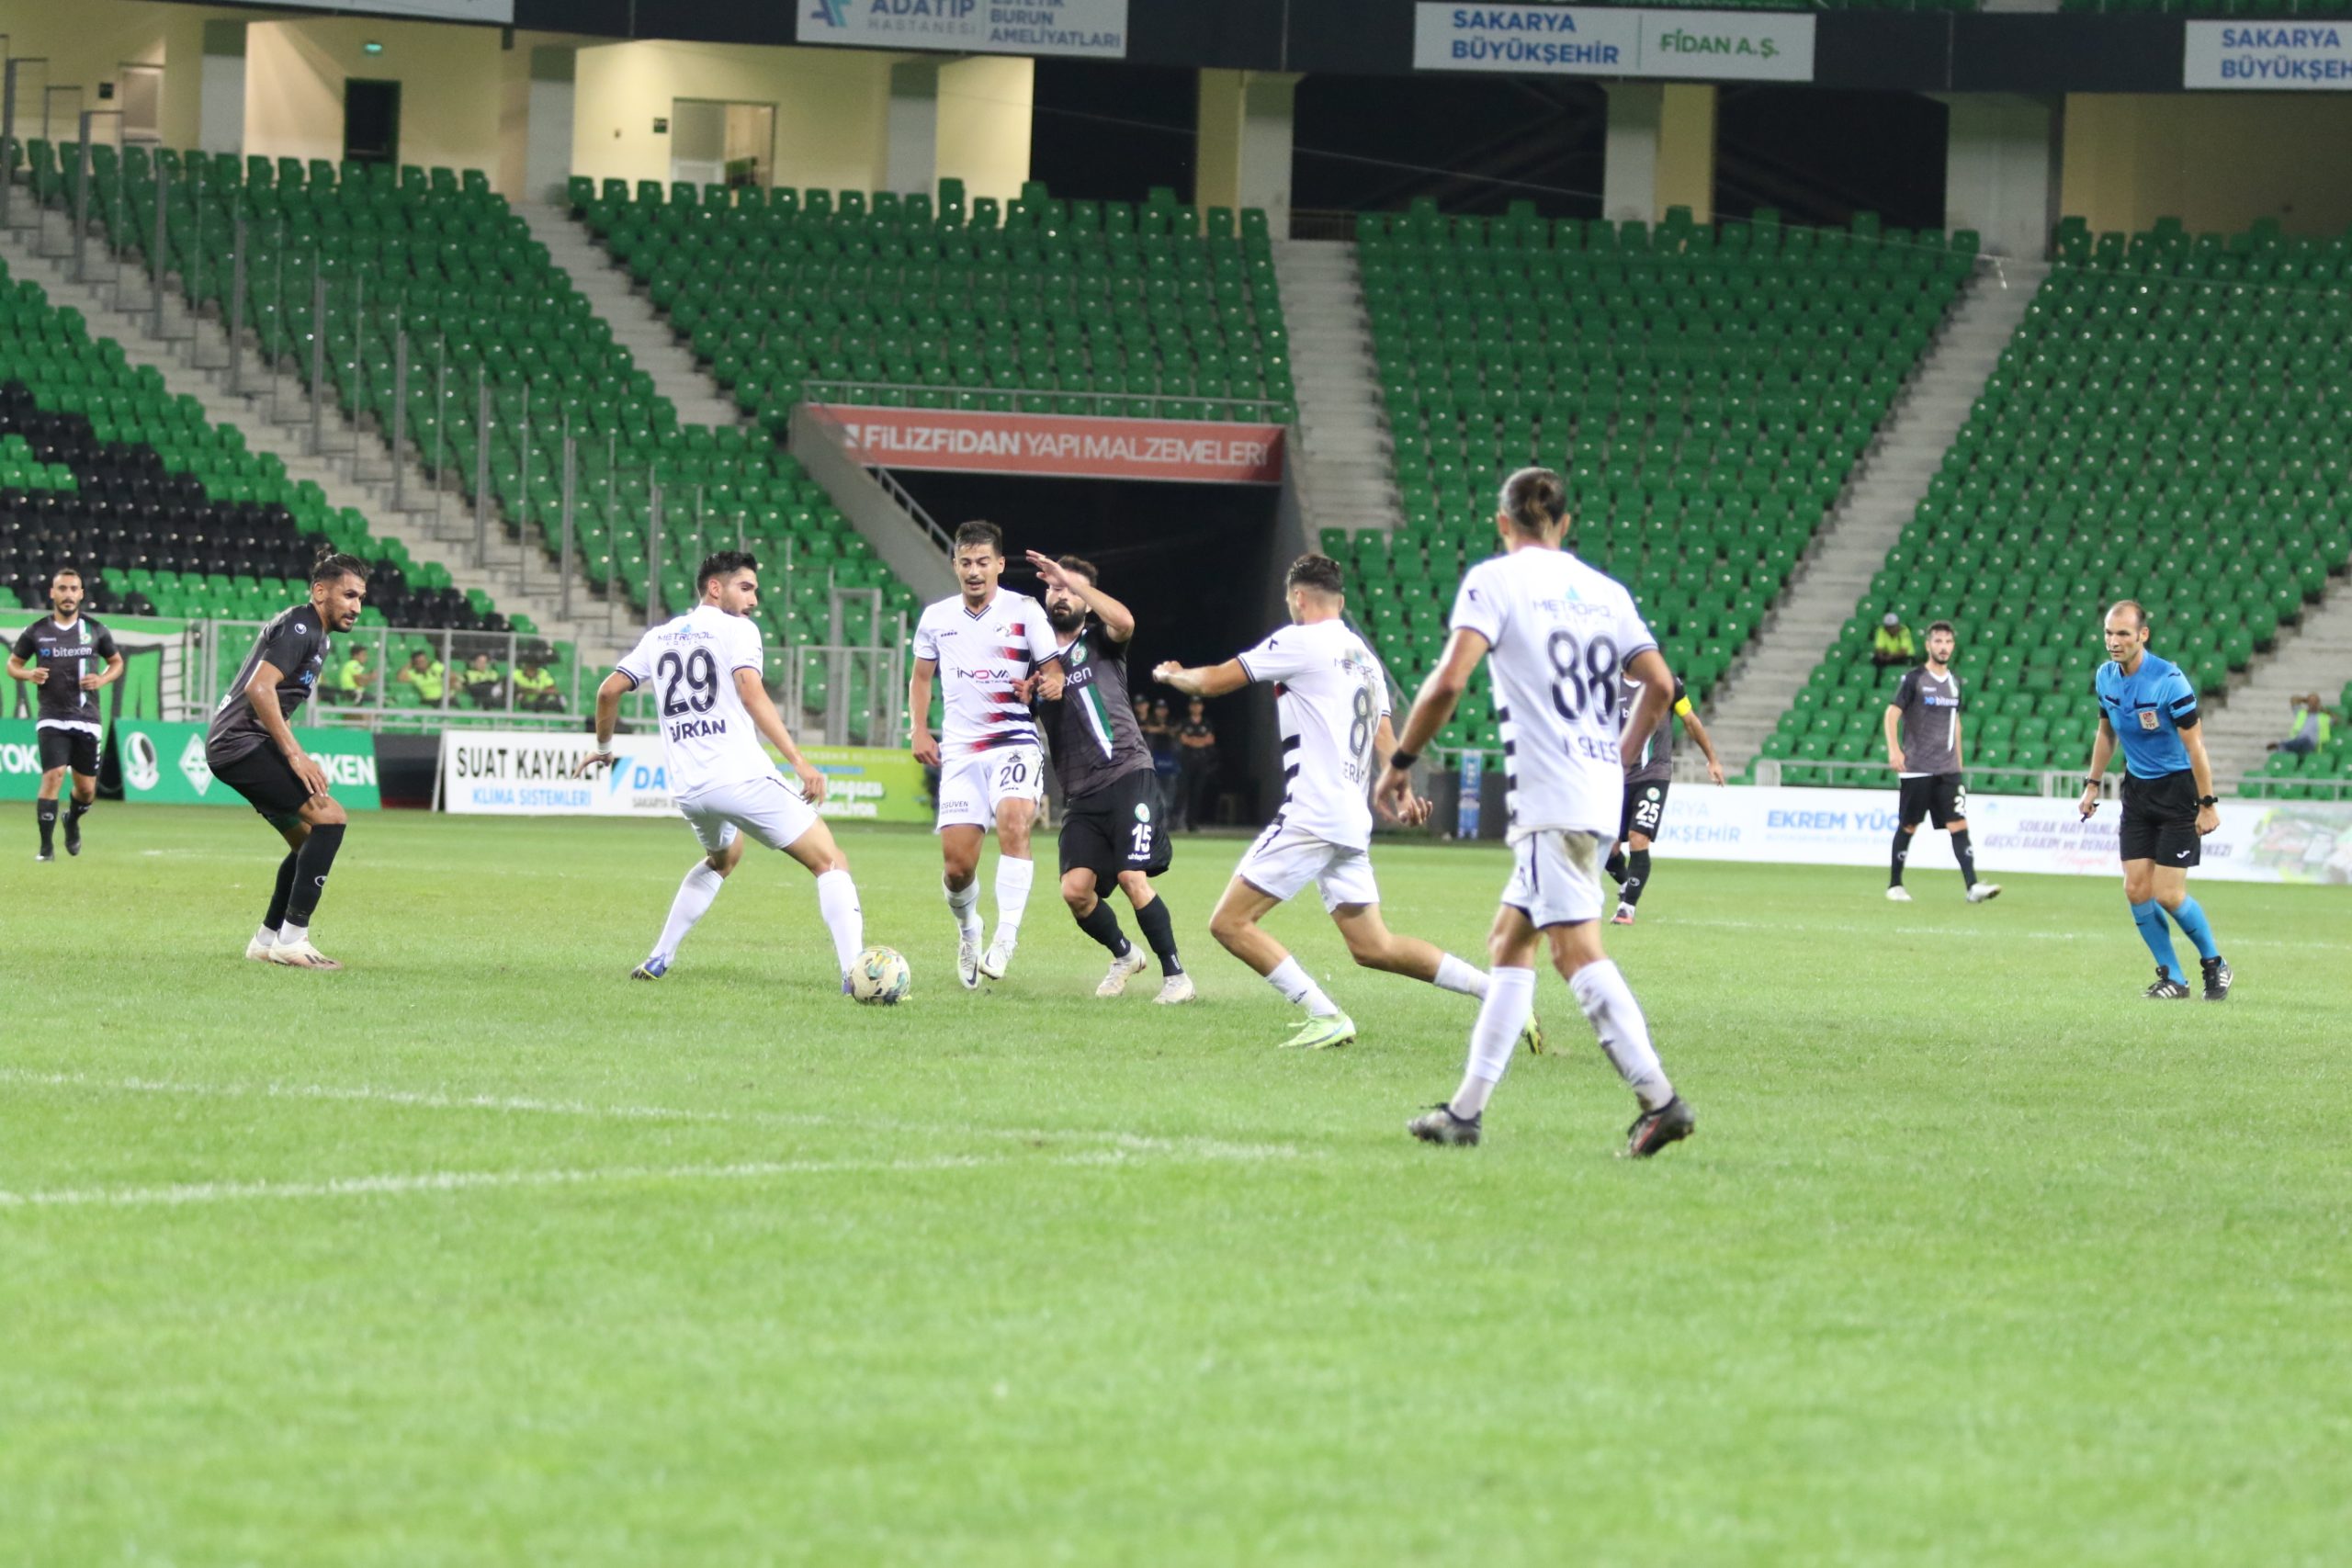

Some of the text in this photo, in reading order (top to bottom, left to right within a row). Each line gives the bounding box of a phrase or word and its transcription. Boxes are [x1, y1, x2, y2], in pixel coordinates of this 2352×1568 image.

[990, 8, 1054, 26] BURUN
[1453, 9, 1577, 33] SAKARYA
[1452, 36, 1620, 65] BÜYÜKŞEHİR
[2222, 28, 2340, 48] SAKARYA
[2222, 54, 2352, 82] BÜYÜKŞEH
[1024, 433, 1080, 457] YAPI
[52, 647, 93, 658] bitexen
[657, 646, 719, 719] 29
[1547, 628, 1620, 726] 88
[1350, 683, 1372, 759] 8
[309, 752, 377, 786] OKEN
[458, 747, 508, 779] SUAT
[1000, 762, 1026, 787] 20
[1635, 800, 1660, 824] 25
[1768, 808, 1900, 832] EKREM YÜC
[1132, 823, 1152, 852] 15
